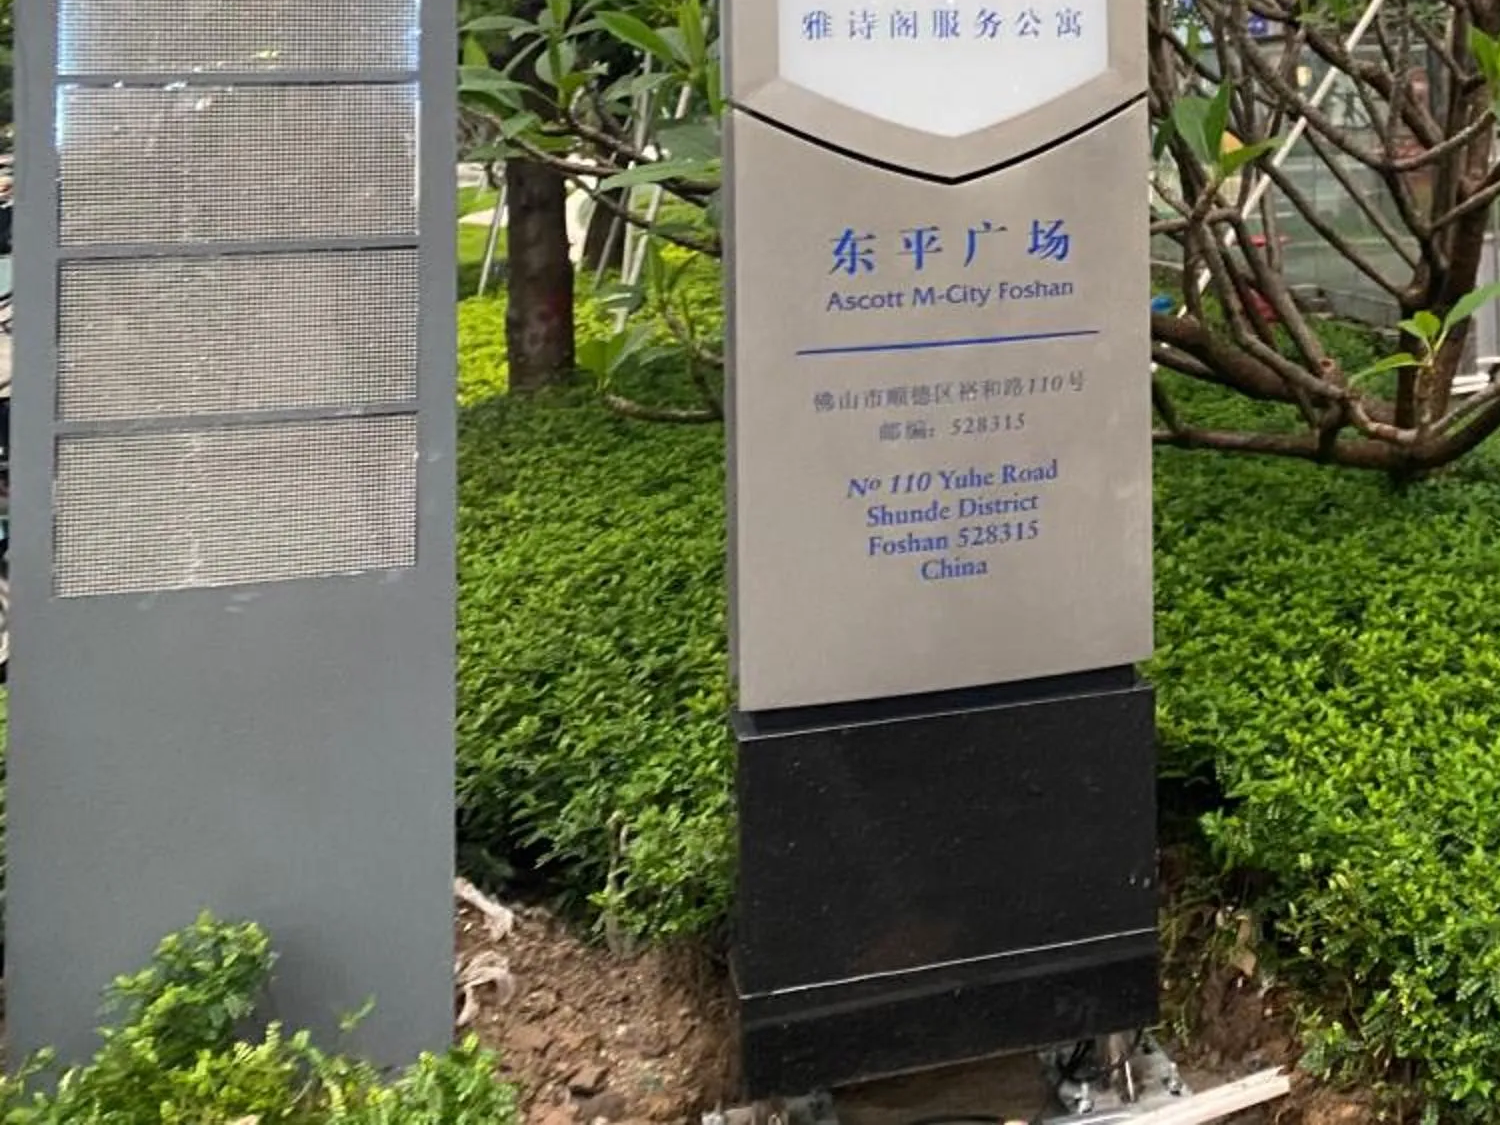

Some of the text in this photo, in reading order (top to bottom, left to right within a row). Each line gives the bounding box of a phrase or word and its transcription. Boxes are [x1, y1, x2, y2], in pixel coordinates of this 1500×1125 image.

[802, 7, 1084, 40] 雅诗阁服务公寓
[829, 218, 1071, 275] 东平广场
[826, 279, 1074, 312] Ascott M-City Foshan
[949, 413, 1026, 437] 528315
[889, 472, 933, 494] 110
[937, 467, 994, 491] Yuhe
[1000, 459, 1059, 485] Road
[866, 492, 1040, 528] Shunde District
[868, 520, 1040, 557] Foshan 528315
[920, 557, 989, 581] China
